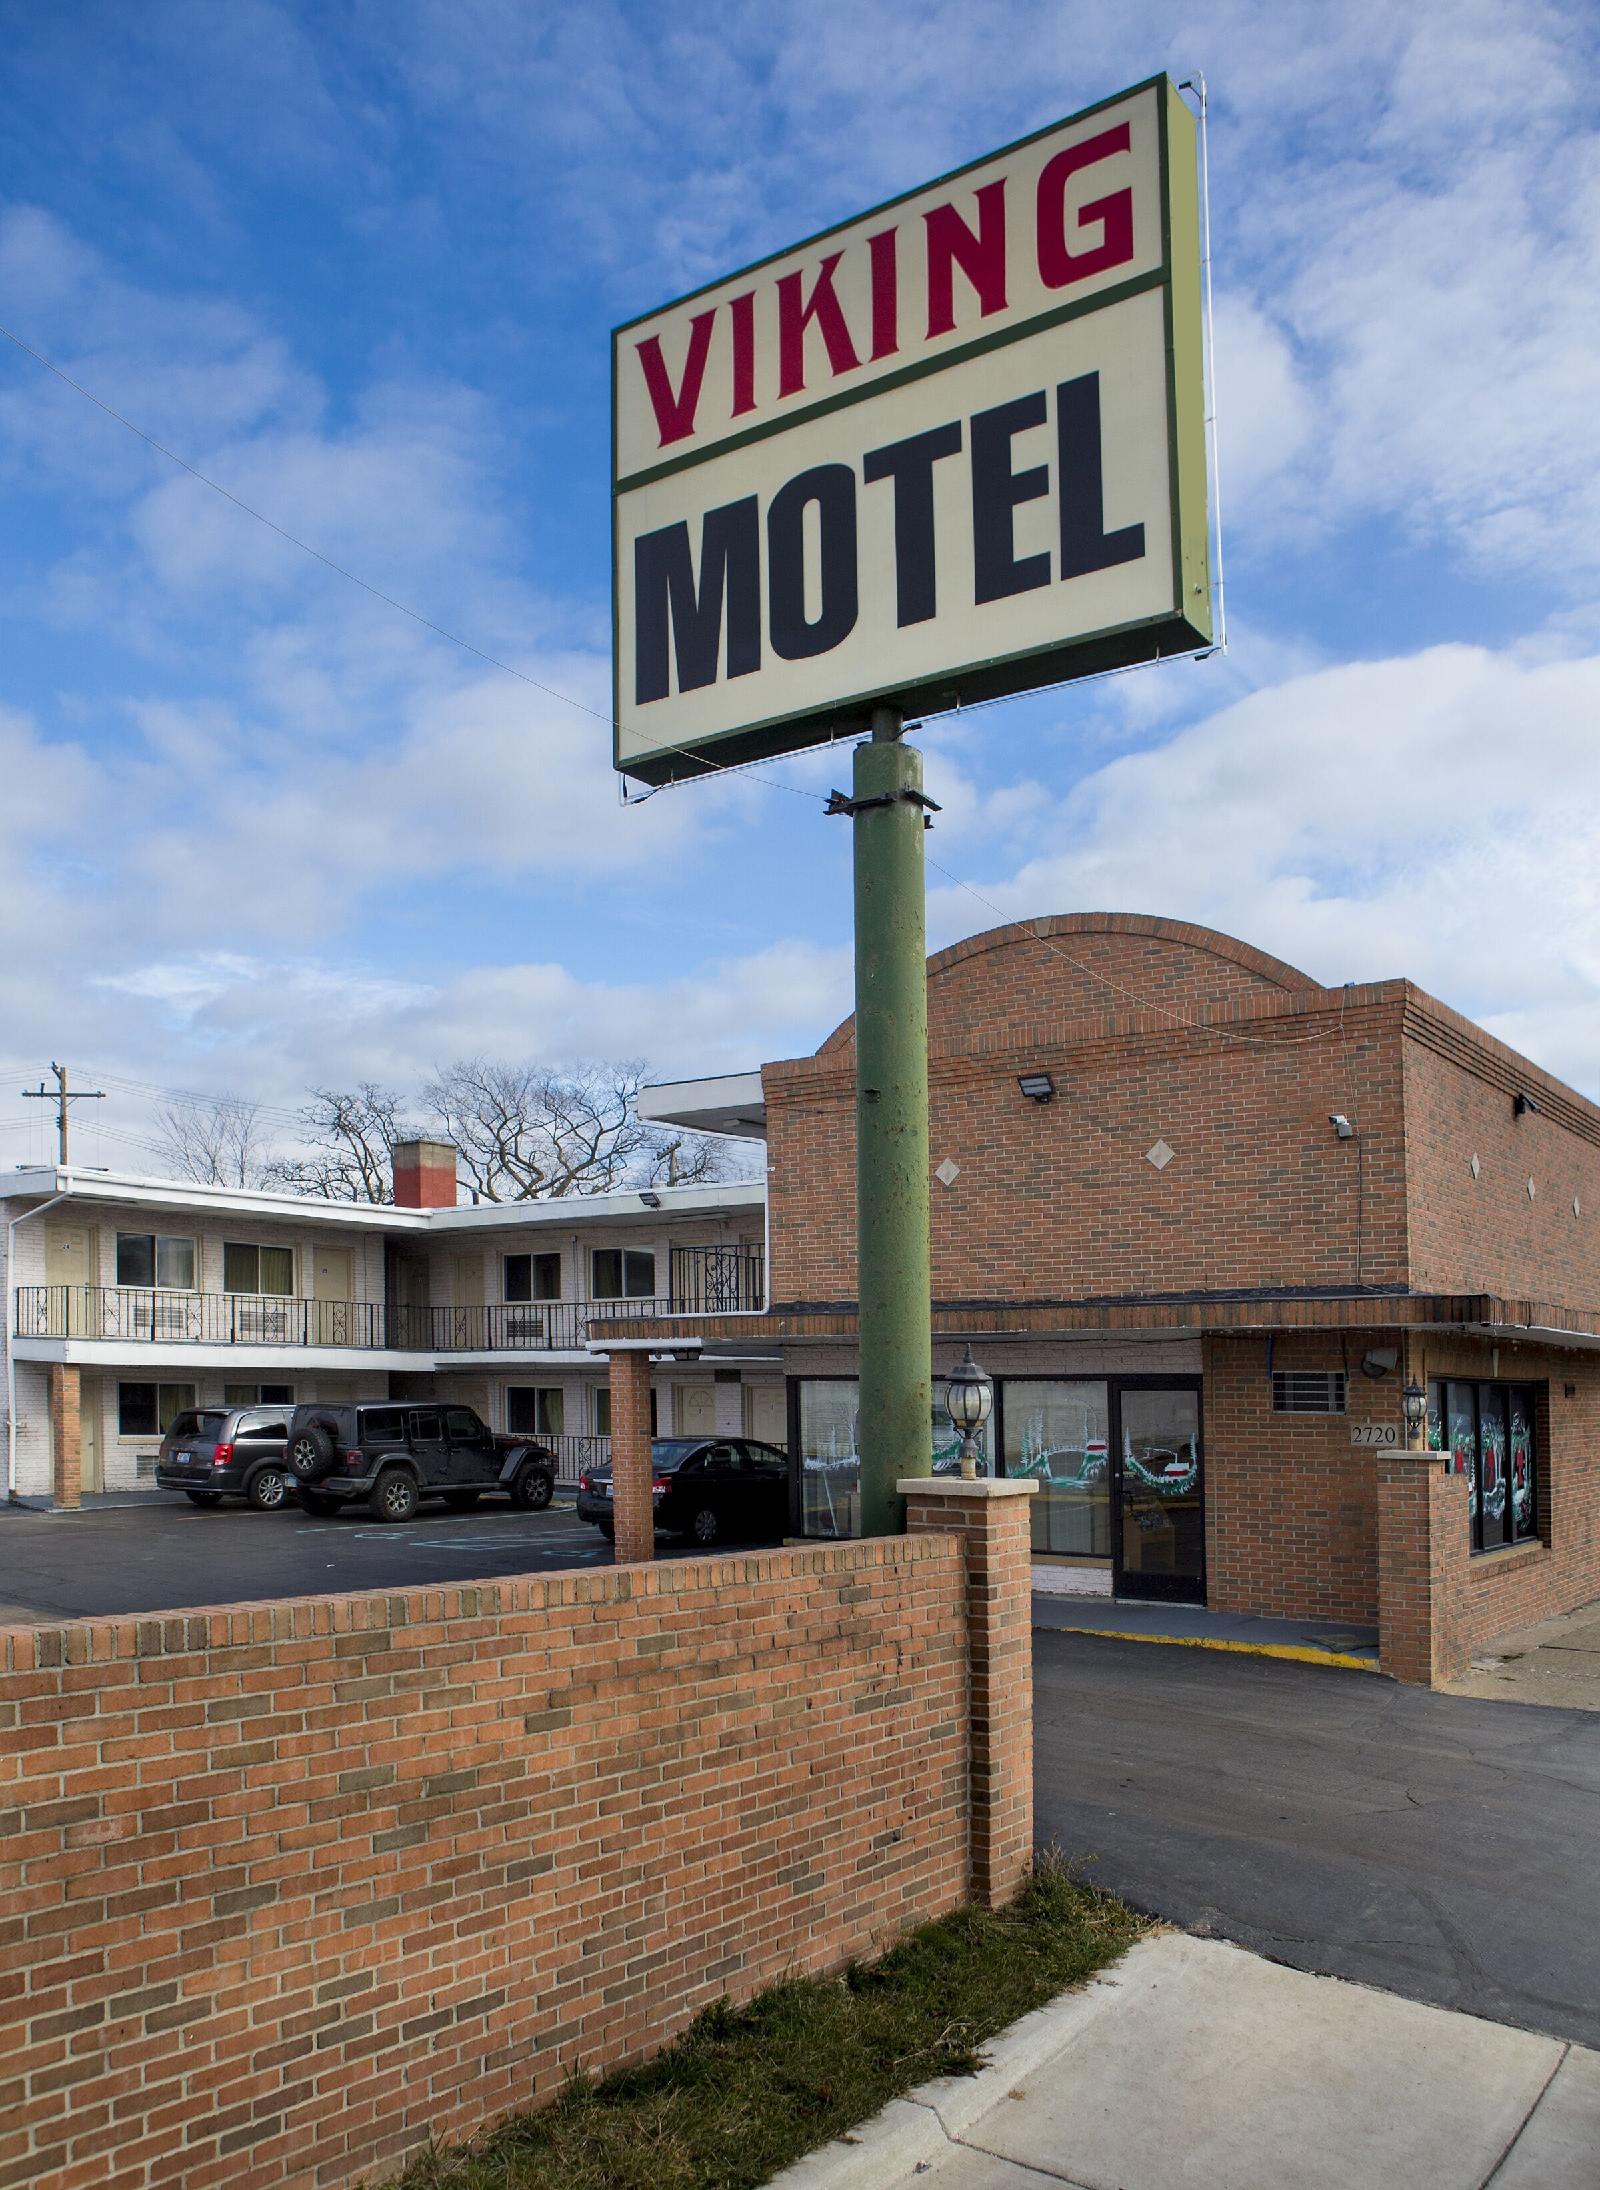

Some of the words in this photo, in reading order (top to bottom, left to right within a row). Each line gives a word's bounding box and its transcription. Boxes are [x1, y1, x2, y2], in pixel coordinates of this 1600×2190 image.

[635, 122, 1134, 448] VIKING
[635, 370, 1145, 706] MOTEL
[1352, 1426, 1396, 1443] 2720
